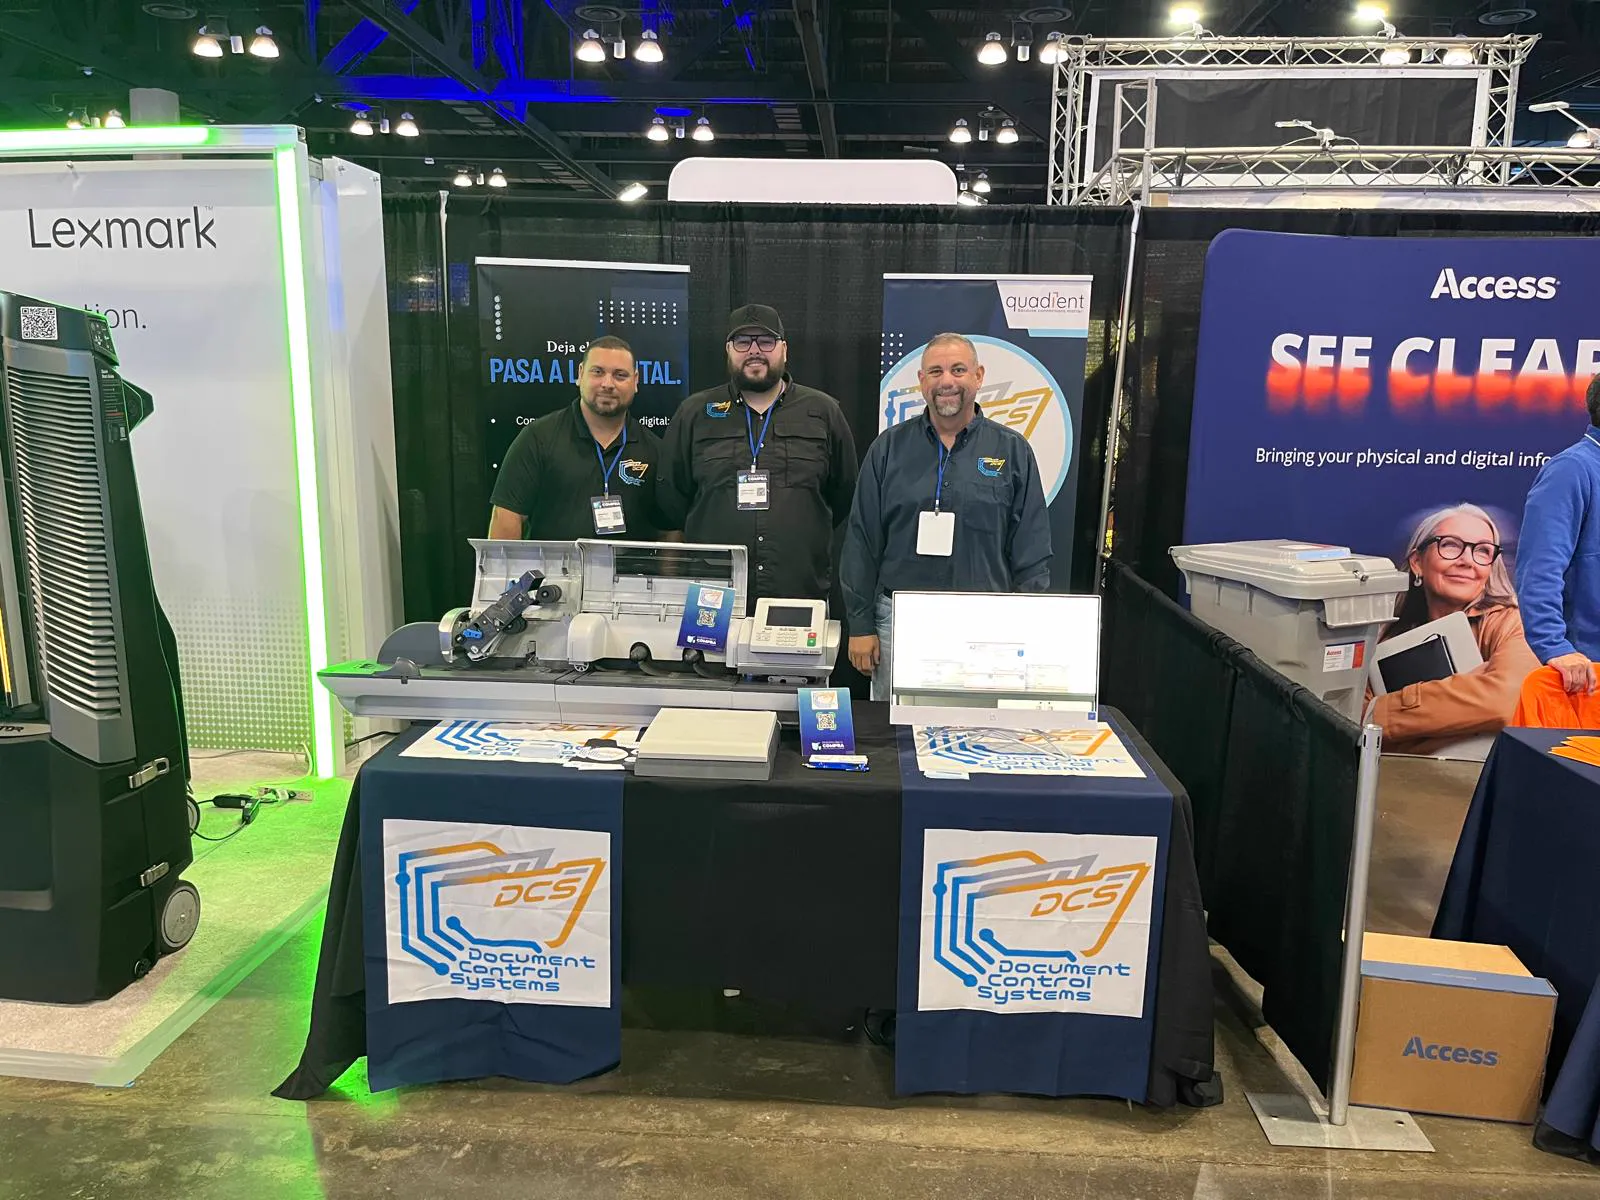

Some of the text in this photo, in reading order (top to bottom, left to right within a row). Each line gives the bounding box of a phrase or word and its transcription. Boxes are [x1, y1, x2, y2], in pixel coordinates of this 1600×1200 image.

[28, 206, 217, 249] Lexmark
[1430, 268, 1557, 300] Access
[1006, 292, 1085, 312] quadient
[547, 340, 576, 355] Deja
[490, 358, 545, 383] PASA
[549, 359, 564, 384] A
[638, 414, 671, 428] digital:
[1256, 447, 1315, 467] Bringing
[1317, 451, 1354, 467] your
[1356, 448, 1421, 468] physical
[1424, 449, 1457, 465] and
[1461, 450, 1514, 470] digital
[494, 878, 581, 906] DCS
[1030, 883, 1124, 917] DCS
[468, 948, 595, 968] Document
[998, 959, 1131, 977] Document
[458, 960, 559, 979] Control
[450, 972, 560, 991] Systems
[987, 973, 1092, 989] Control
[977, 984, 1092, 1006] Systems
[1402, 1036, 1501, 1067] Access
